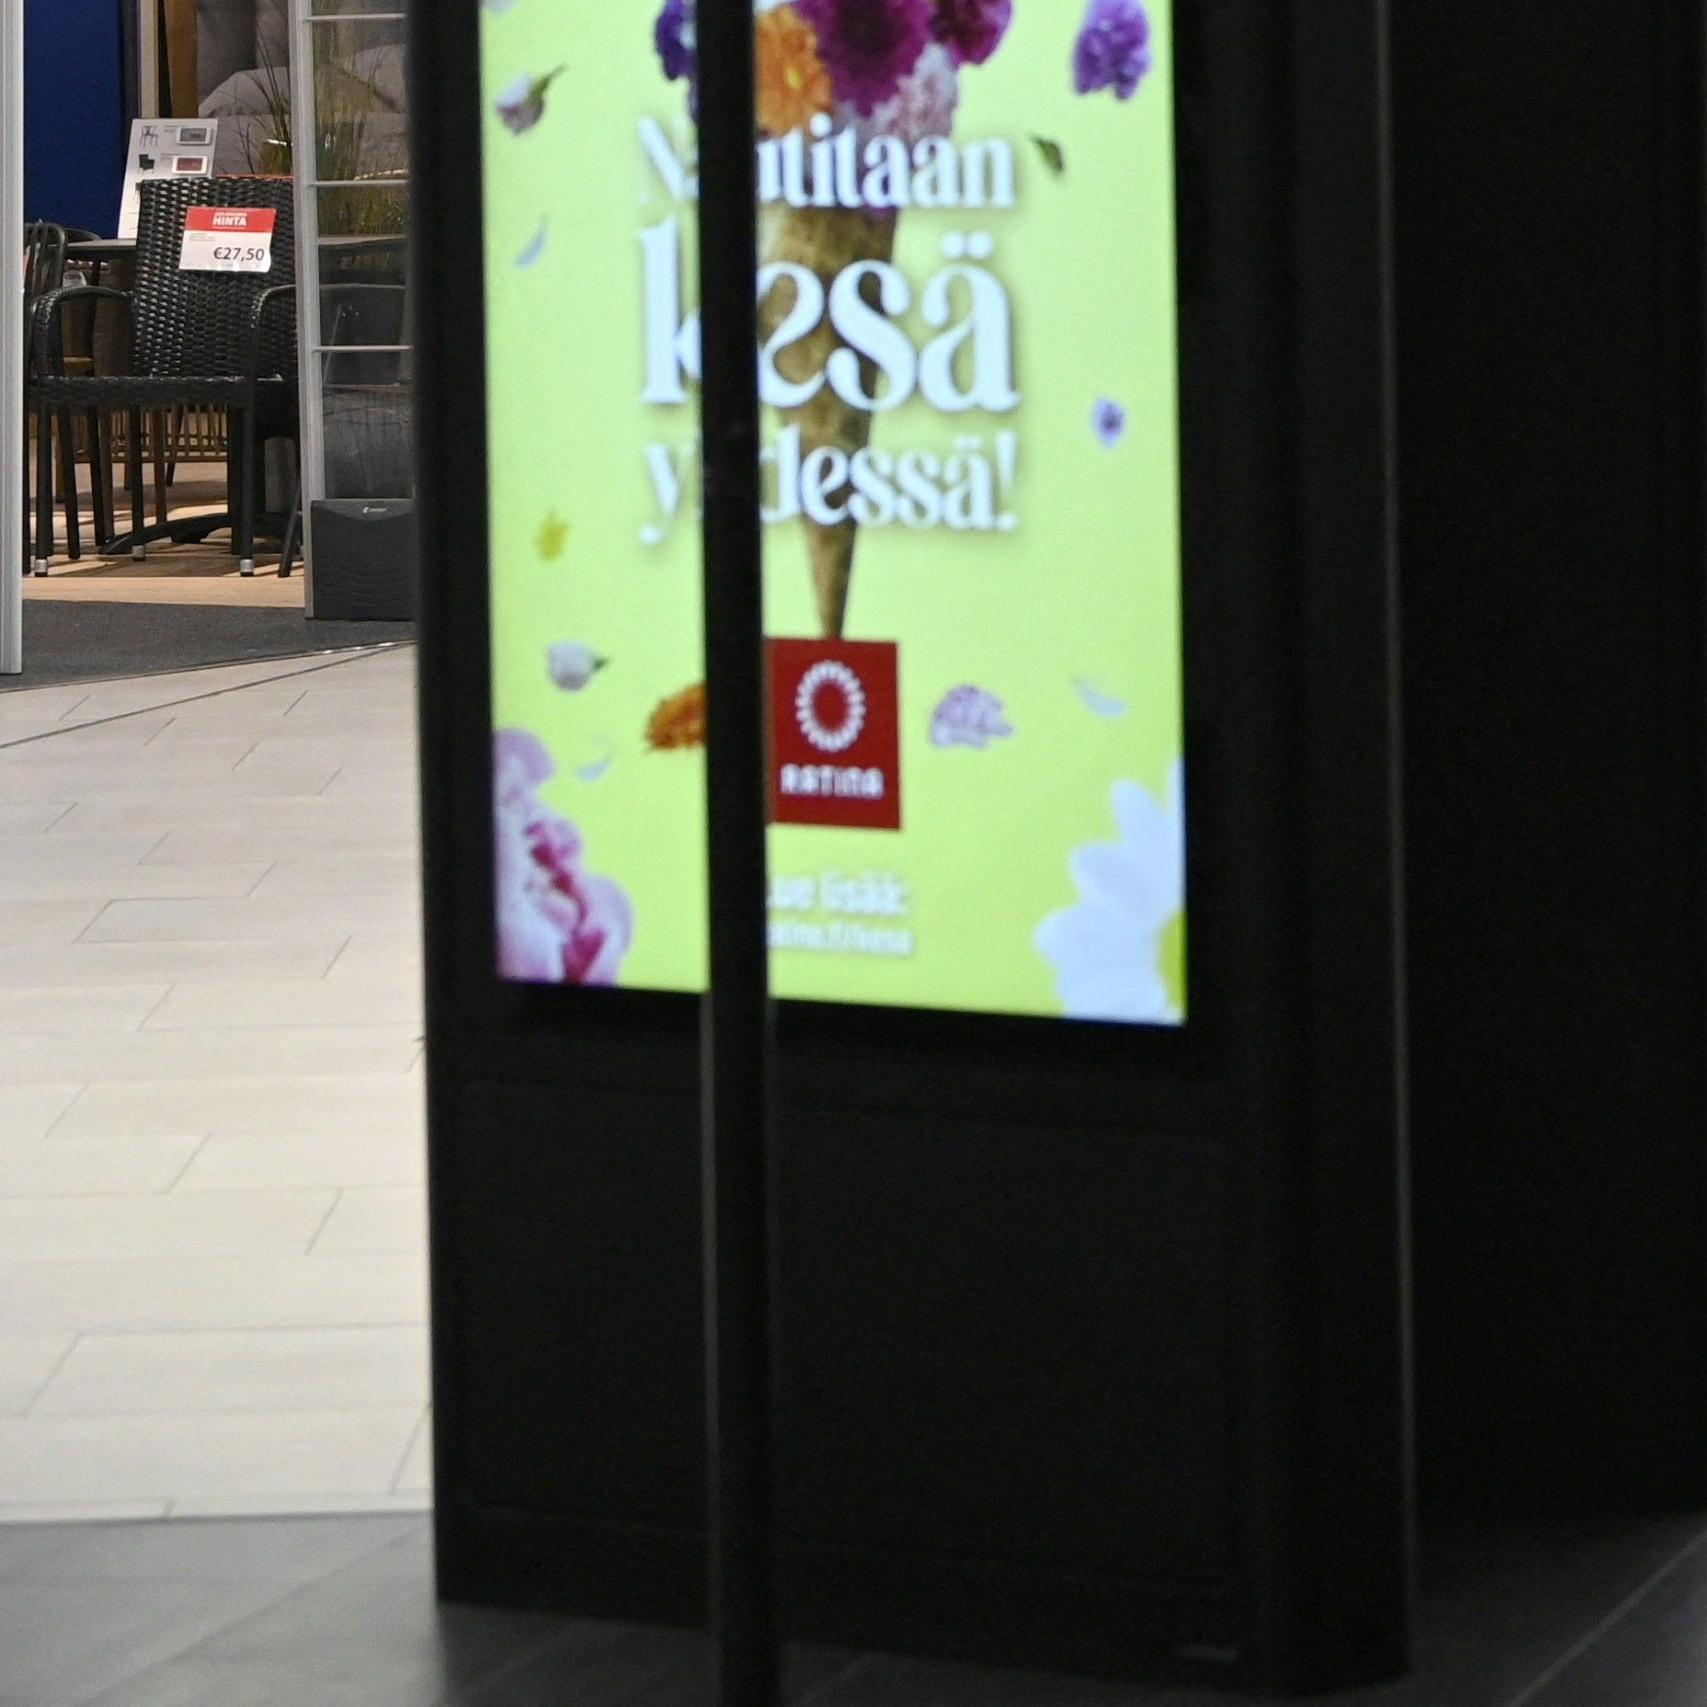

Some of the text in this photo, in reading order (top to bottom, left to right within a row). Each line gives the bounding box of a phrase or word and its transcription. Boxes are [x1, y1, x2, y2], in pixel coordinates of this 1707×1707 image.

[637, 112, 1018, 209] Ntitaan
[212, 215, 248, 227] HINTA
[213, 246, 265, 263] €27,50
[637, 422, 1018, 545] ydessä!
